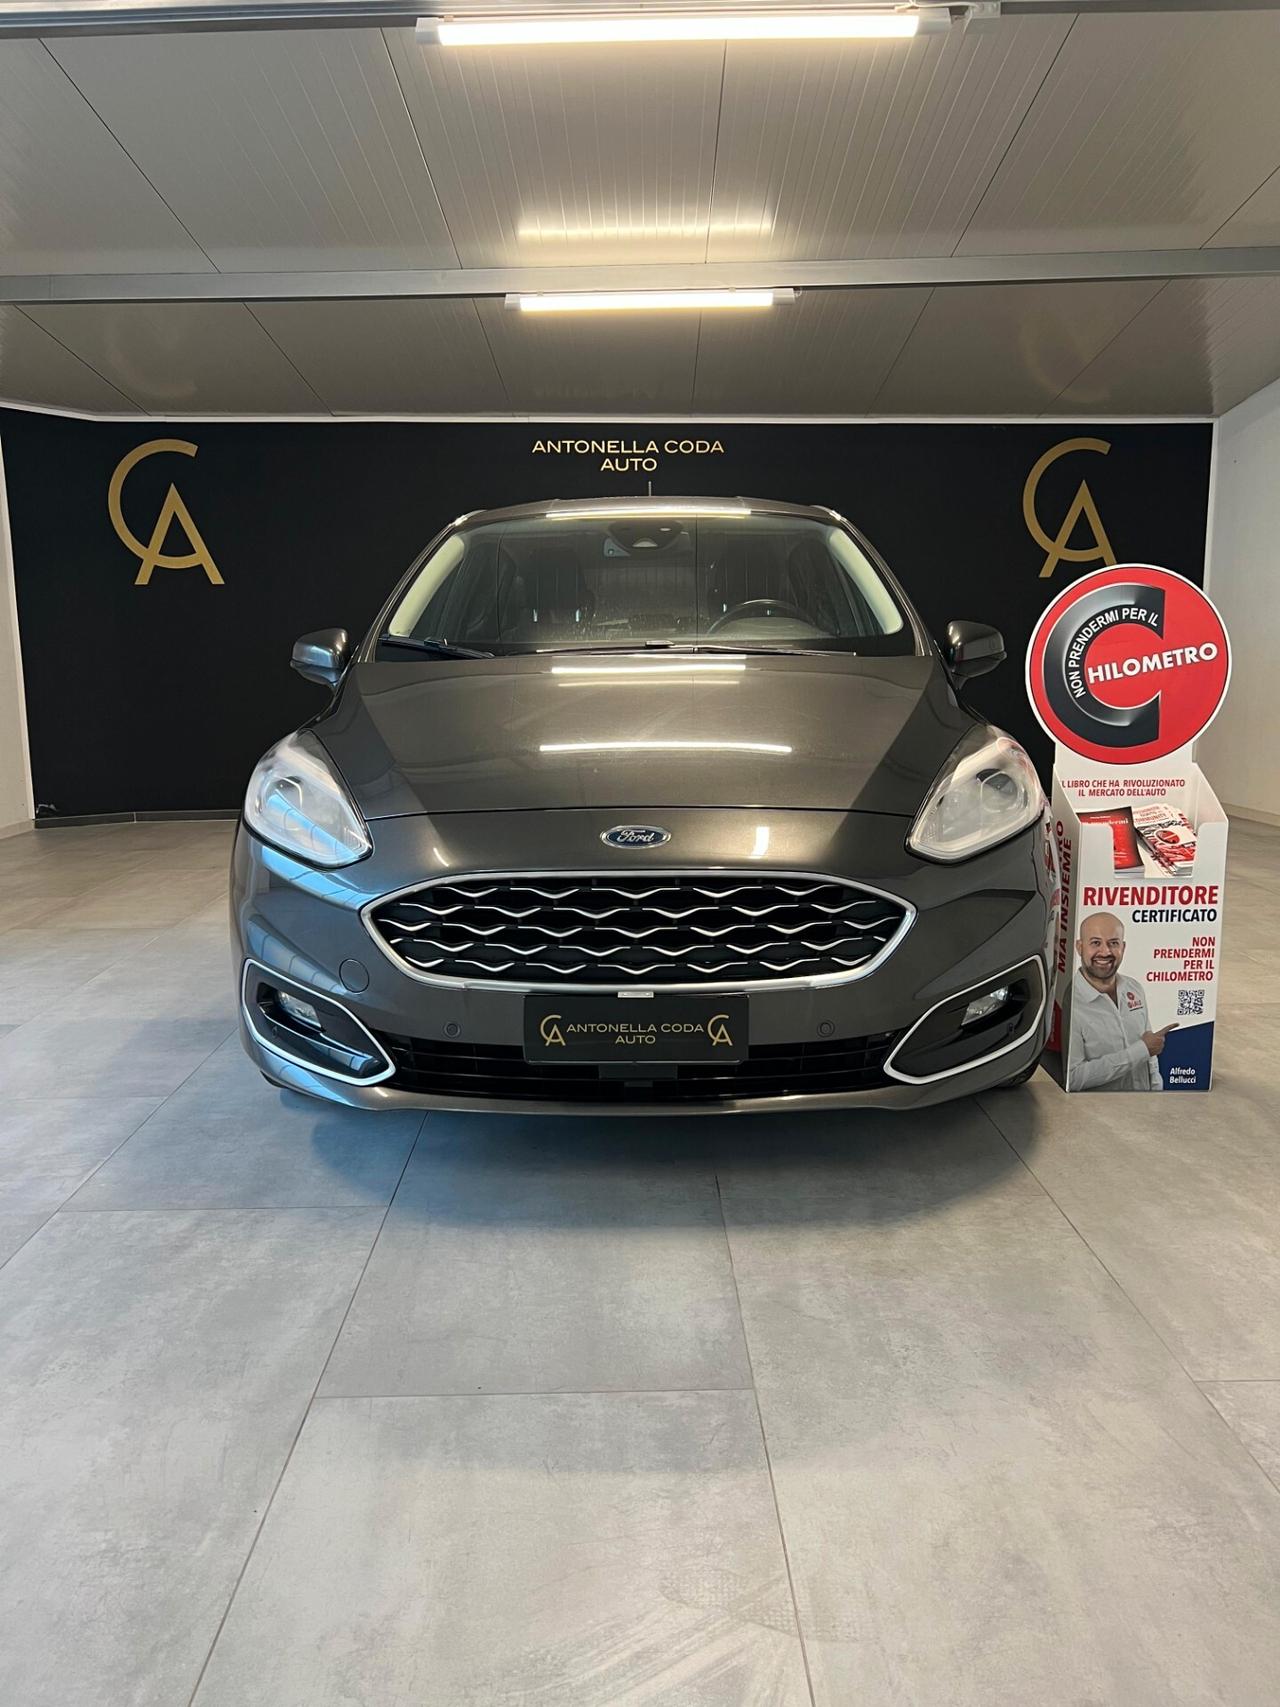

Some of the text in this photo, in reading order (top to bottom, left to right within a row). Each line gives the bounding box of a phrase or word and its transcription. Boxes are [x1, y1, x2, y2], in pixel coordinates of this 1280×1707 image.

[532, 440, 725, 454] ANTONELLA CODA
[600, 458, 657, 472] AUTO
[1068, 607, 1160, 699] NON PRENDERMI PER IL
[1067, 780, 1090, 788] LIBRO
[1092, 780, 1107, 788] CHE
[1108, 780, 1120, 788] HA
[1123, 779, 1185, 788] RIVOLUZIONATO
[1078, 788, 1167, 797] IL MERCATO DELL'AUTO
[616, 829, 655, 842] Ford
[1083, 885, 1219, 906] RIVENDITORE
[1057, 838, 1072, 974] MA INSIEME
[1132, 908, 1217, 923] CERTIFICATO
[1192, 936, 1216, 947] NON
[1153, 948, 1215, 959] PRENDERMI
[1183, 960, 1215, 970] PER IL
[1146, 971, 1213, 982] CHILOMETRO
[566, 1023, 704, 1033] ANTONELLA CODA
[615, 1035, 656, 1045] AUTO
[1170, 1067, 1195, 1075] Alfredo
[1169, 1075, 1196, 1084] Bellucci
